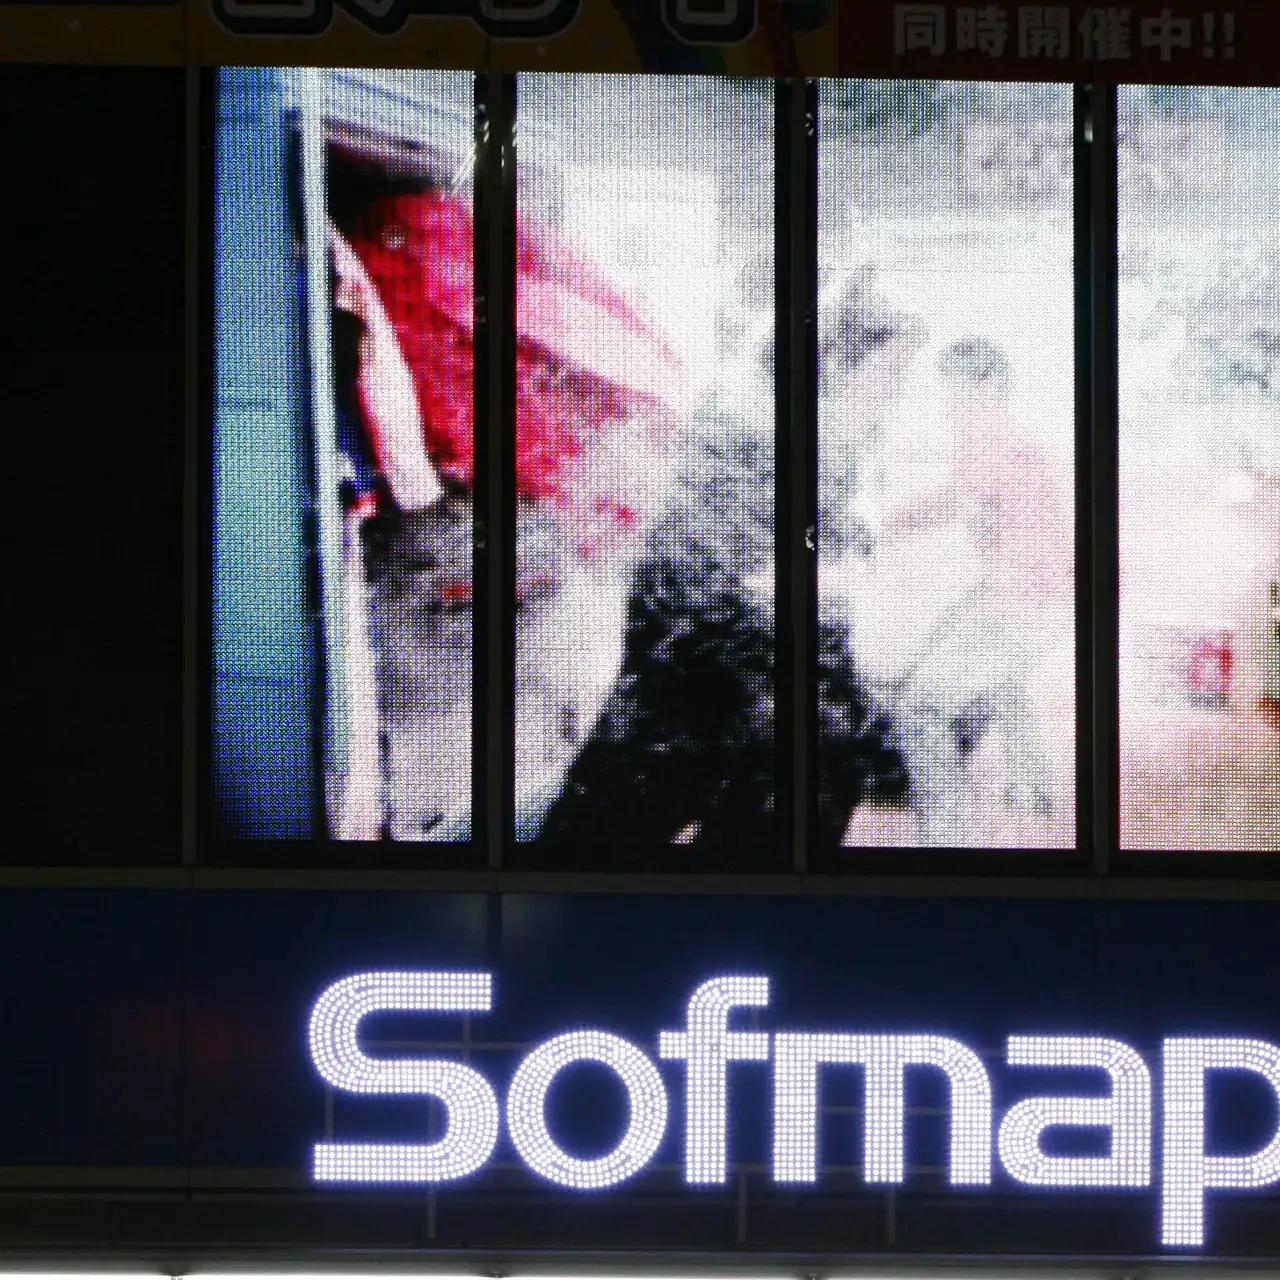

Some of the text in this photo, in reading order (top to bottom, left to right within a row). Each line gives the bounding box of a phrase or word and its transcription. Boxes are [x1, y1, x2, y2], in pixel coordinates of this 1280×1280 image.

[893, 3, 1236, 61] 同時開催中!!
